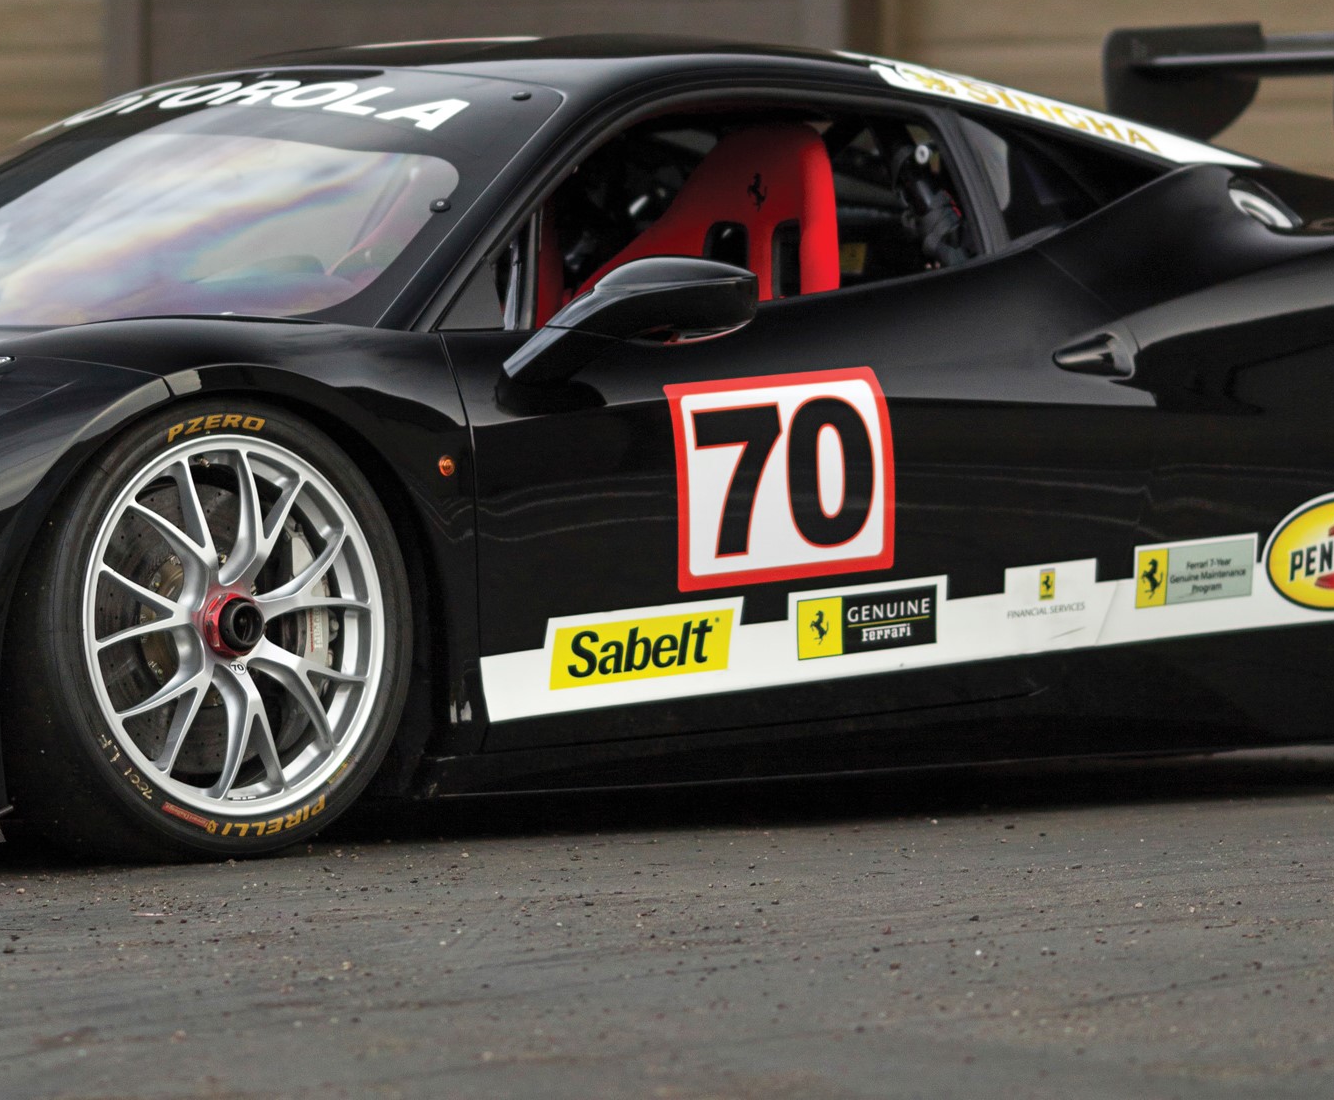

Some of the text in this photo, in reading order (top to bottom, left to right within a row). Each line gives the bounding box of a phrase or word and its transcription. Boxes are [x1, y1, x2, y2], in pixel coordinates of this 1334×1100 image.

[19, 80, 470, 144] OTOROLA
[965, 80, 1163, 154] SINGHA
[690, 394, 876, 559] 70
[1170, 569, 1246, 584] Genuine Maintenance
[1191, 583, 1222, 594] Program
[847, 597, 931, 623] GENUINE
[1006, 601, 1086, 619] FINANCIAL SERVICES
[861, 623, 912, 642] Ferrari
[567, 618, 713, 678] Sabelt
[230, 663, 244, 671] 70
[221, 793, 326, 837] PIRELLI
